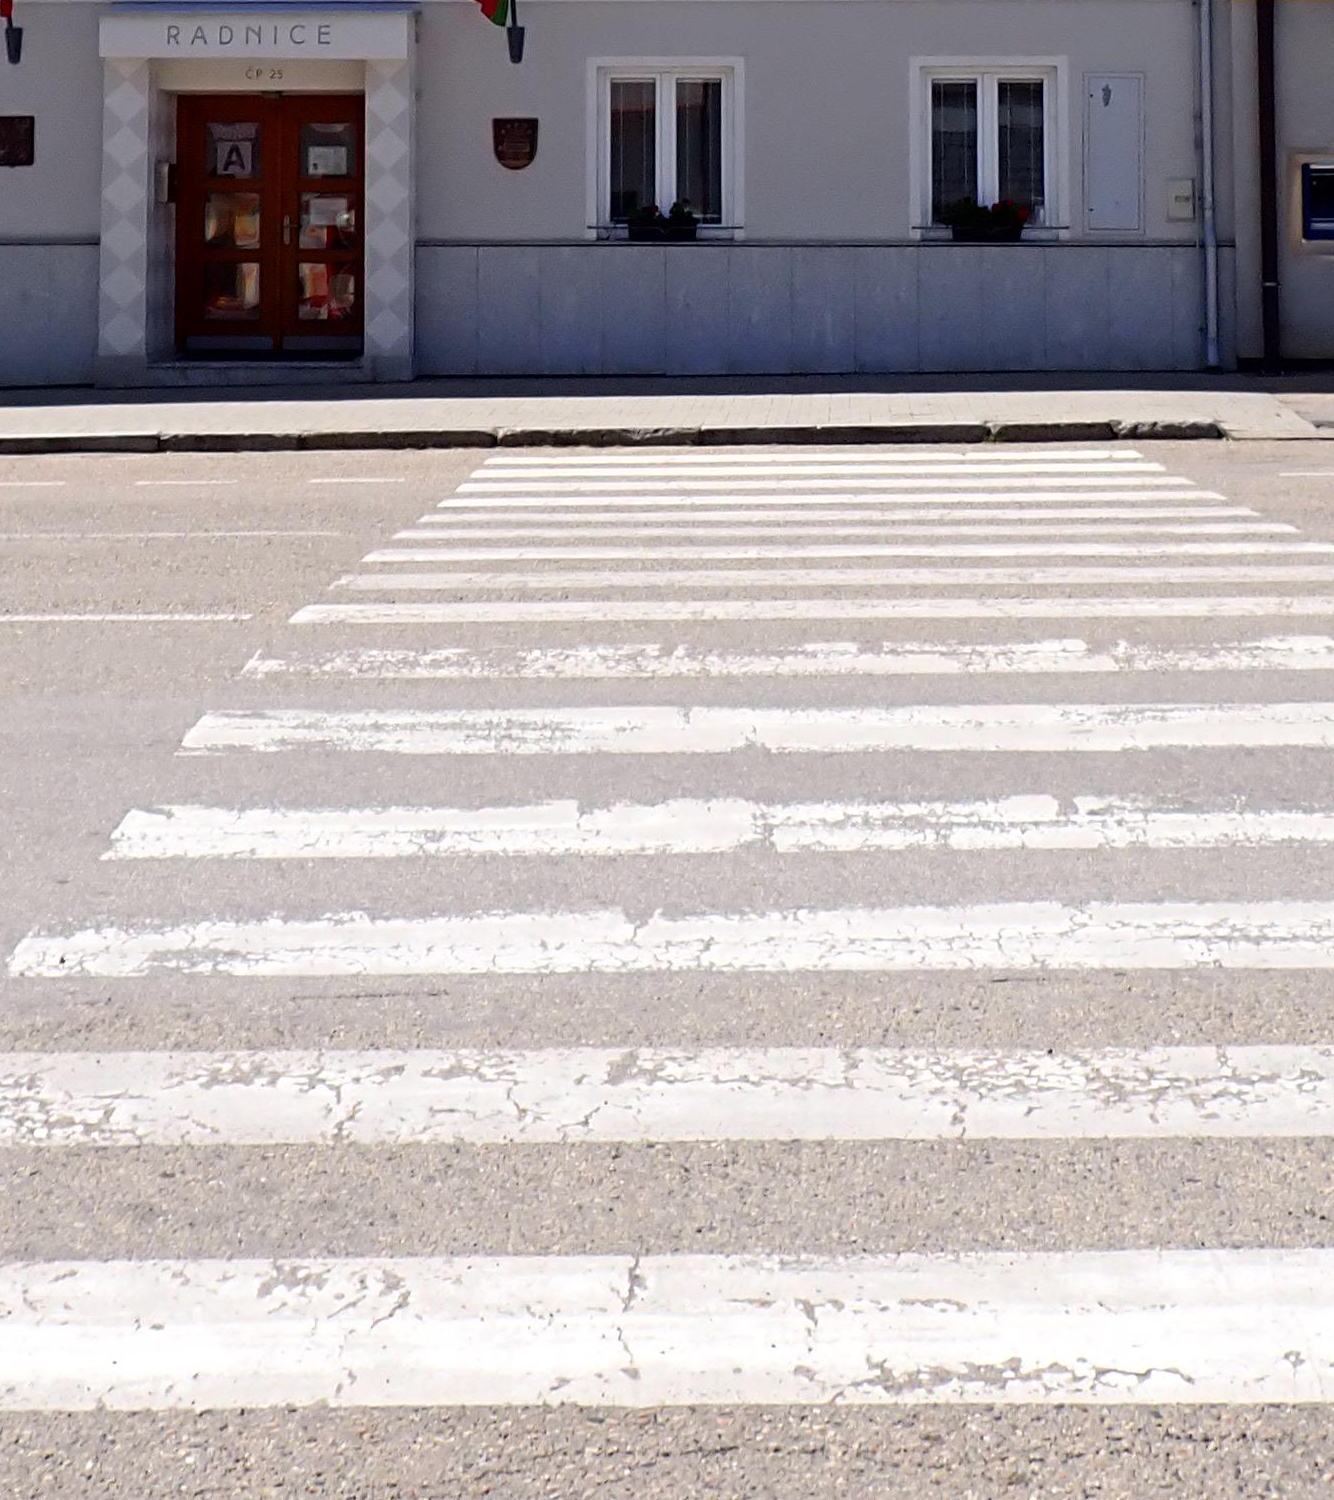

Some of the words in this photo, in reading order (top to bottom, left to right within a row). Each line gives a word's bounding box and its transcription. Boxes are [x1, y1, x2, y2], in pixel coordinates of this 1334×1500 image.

[167, 24, 331, 45] RADNICE
[245, 68, 263, 79] ČP
[269, 69, 284, 79] 25
[223, 144, 246, 171] A
